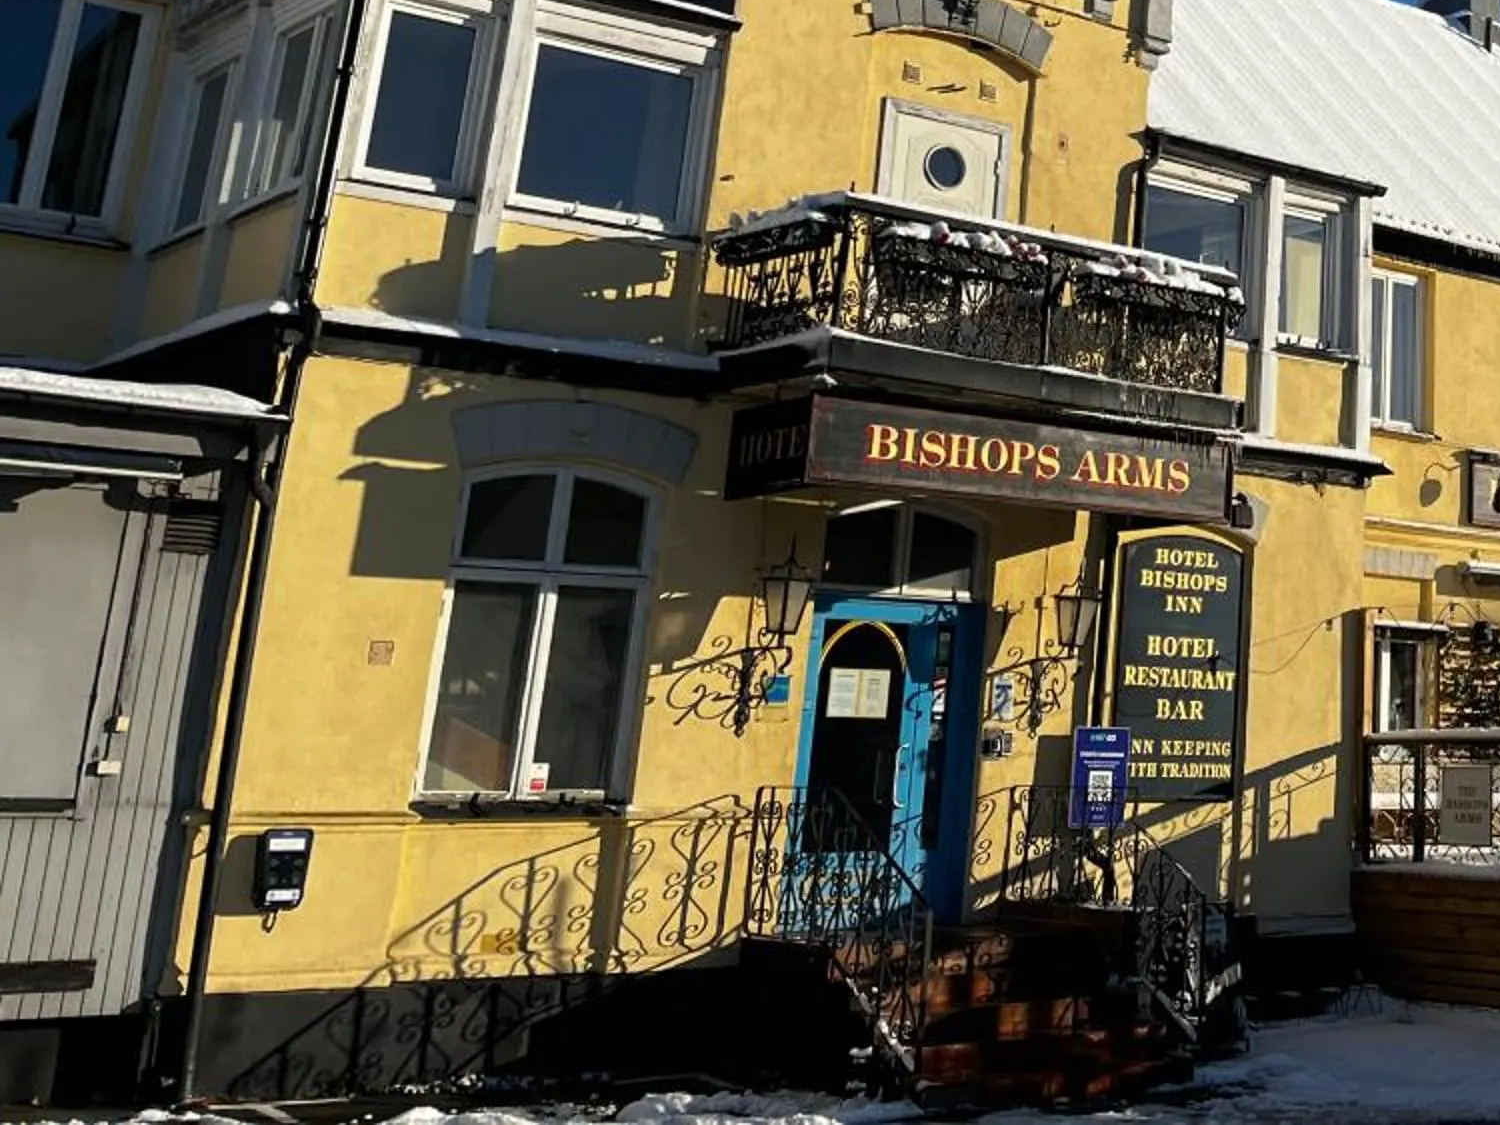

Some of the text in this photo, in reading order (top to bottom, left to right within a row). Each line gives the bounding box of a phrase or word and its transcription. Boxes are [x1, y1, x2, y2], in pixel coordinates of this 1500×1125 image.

[739, 424, 808, 467] HOTE
[866, 424, 1190, 493] BISHOPS ARMS
[1155, 548, 1219, 568] HOTEL
[1140, 569, 1228, 593] BISHOPS
[1164, 595, 1203, 614] INN
[1147, 635, 1219, 658] HOTEL
[1123, 664, 1236, 691] RESTAURANT
[1155, 698, 1205, 720] BAR
[1131, 739, 1232, 758] NN KEEPING
[1127, 762, 1157, 778] ITH
[1161, 762, 1232, 779] TRADITION
